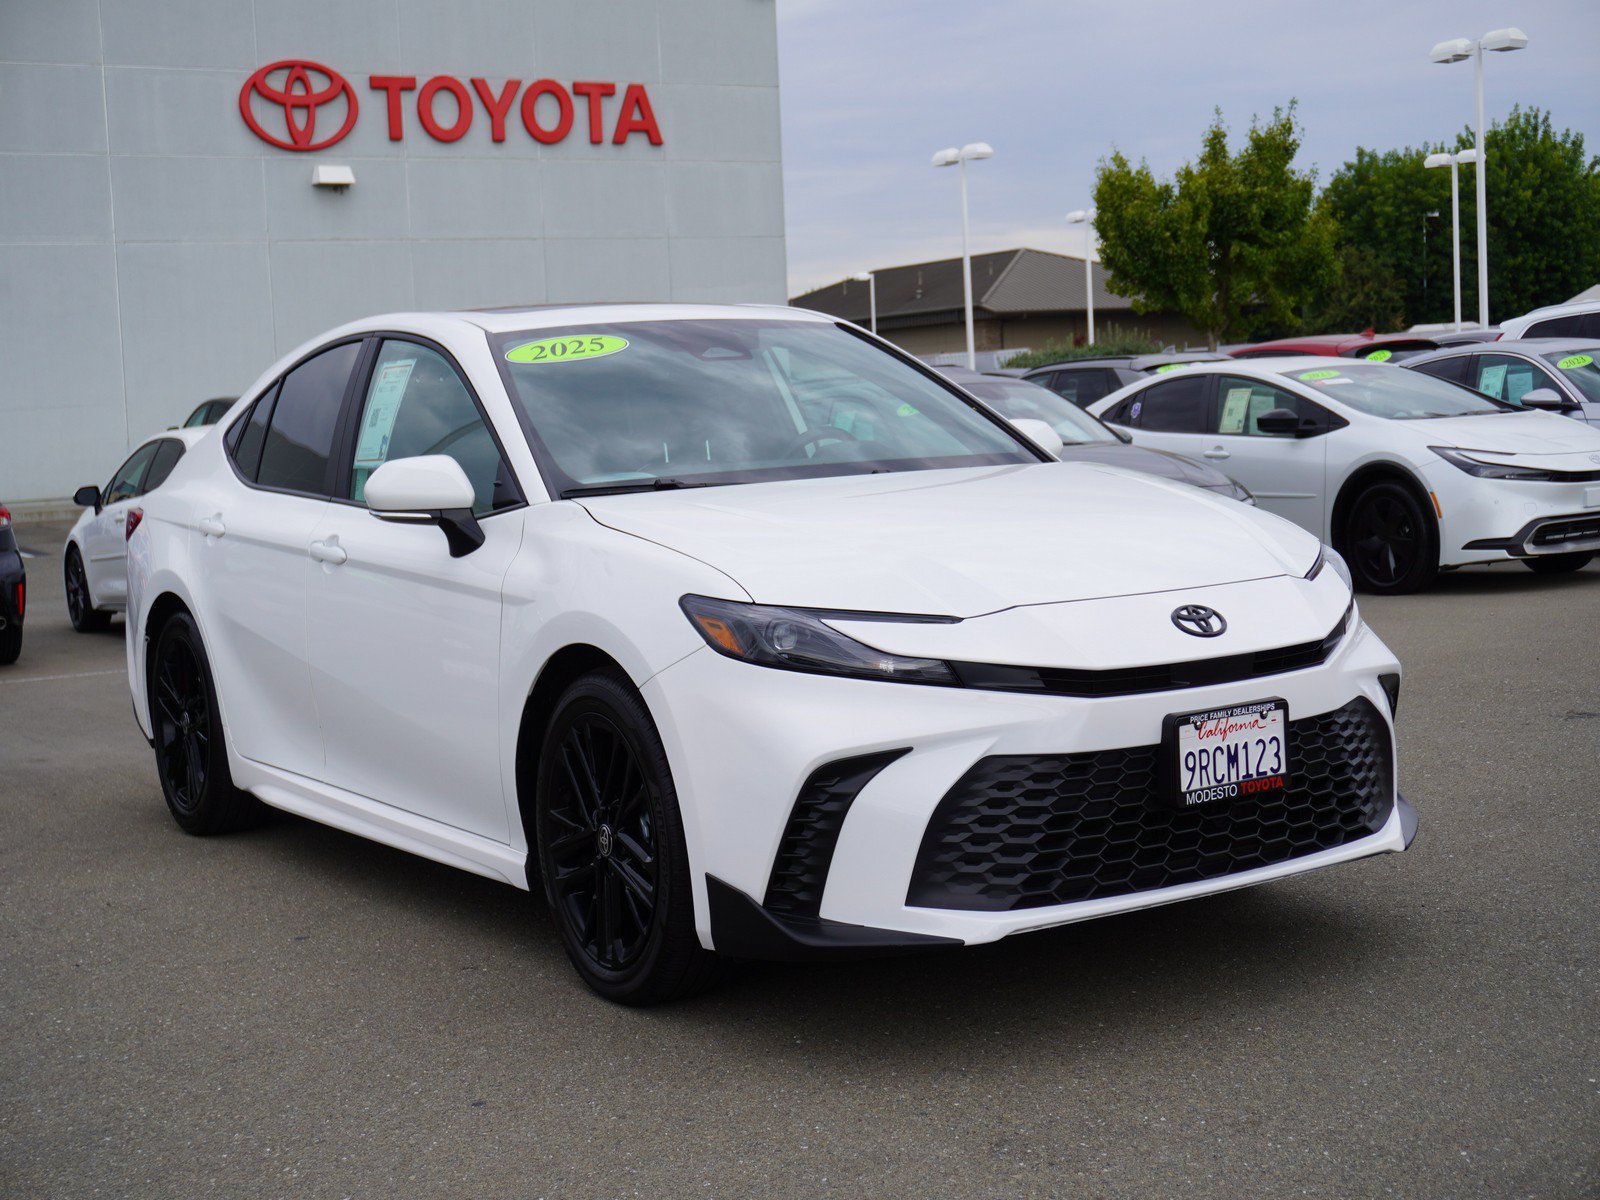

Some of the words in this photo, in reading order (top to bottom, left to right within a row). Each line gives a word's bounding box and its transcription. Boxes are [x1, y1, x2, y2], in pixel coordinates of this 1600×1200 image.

[369, 75, 664, 145] TOYOTA
[530, 337, 605, 361] 2025
[1210, 709, 1232, 720] FAMILY
[1198, 717, 1266, 742] California
[1184, 735, 1282, 791] 9RCM123
[1186, 784, 1238, 805] MODESTO
[1240, 777, 1283, 794] TOYOTA
